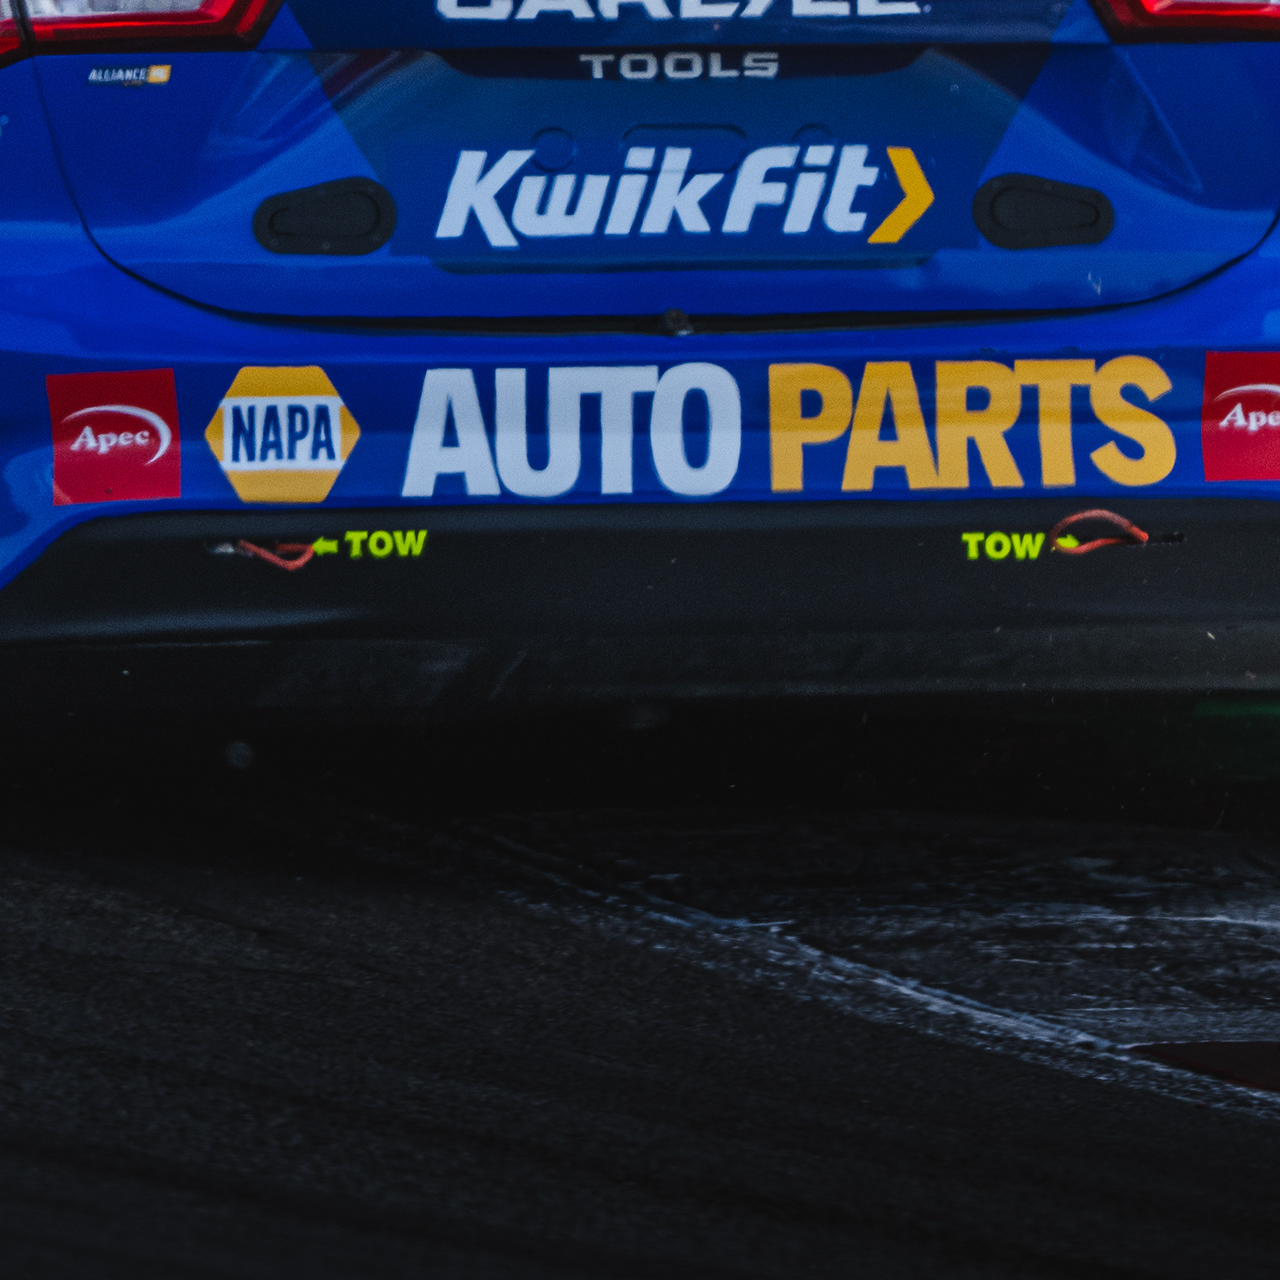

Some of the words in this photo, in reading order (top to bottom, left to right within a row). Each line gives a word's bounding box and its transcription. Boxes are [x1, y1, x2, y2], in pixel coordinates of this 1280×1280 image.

[579, 52, 780, 80] TOOLS
[70, 422, 151, 455] Apec
[230, 403, 336, 463] NAPA
[401, 362, 742, 497] AUTO
[768, 355, 1177, 493] PARTS
[343, 529, 429, 559] TOW
[960, 530, 1046, 560] TOW
